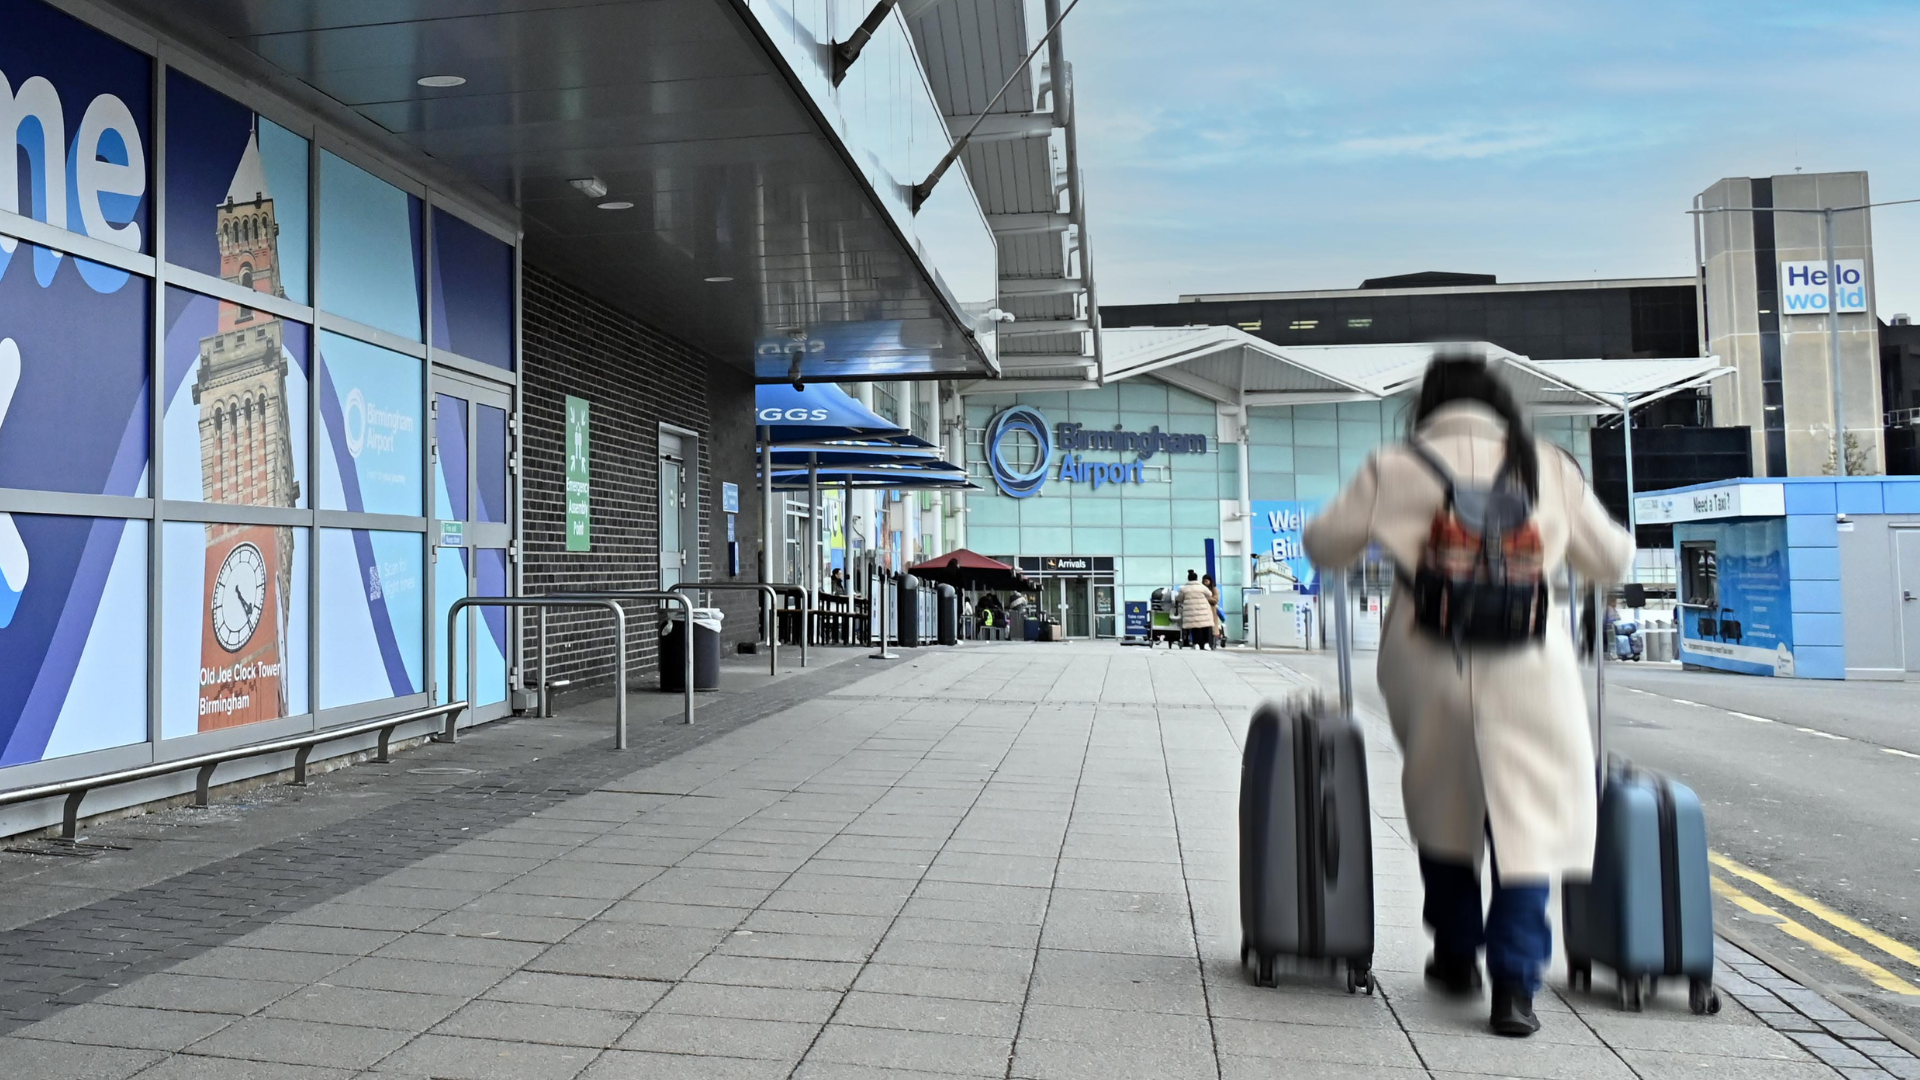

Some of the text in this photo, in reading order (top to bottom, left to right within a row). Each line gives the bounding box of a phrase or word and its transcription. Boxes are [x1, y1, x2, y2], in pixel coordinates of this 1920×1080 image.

[1788, 264, 1860, 286] Helo
[1786, 286, 1864, 309] wold
[367, 403, 414, 434] Birmingham
[755, 407, 828, 421] GGS
[367, 428, 395, 455] Airport
[1057, 422, 1207, 460] Birmingham
[1060, 454, 1145, 490] Airport
[566, 477, 589, 497] Emergency
[569, 499, 588, 518] Assembly
[1693, 492, 1731, 513] Need a Taxi?
[573, 520, 584, 536] Point
[1268, 508, 1304, 533] Wel
[1058, 559, 1086, 569] Arrivals
[200, 661, 281, 686] Old Joe Clock Tower
[200, 692, 250, 715] Birmingham
